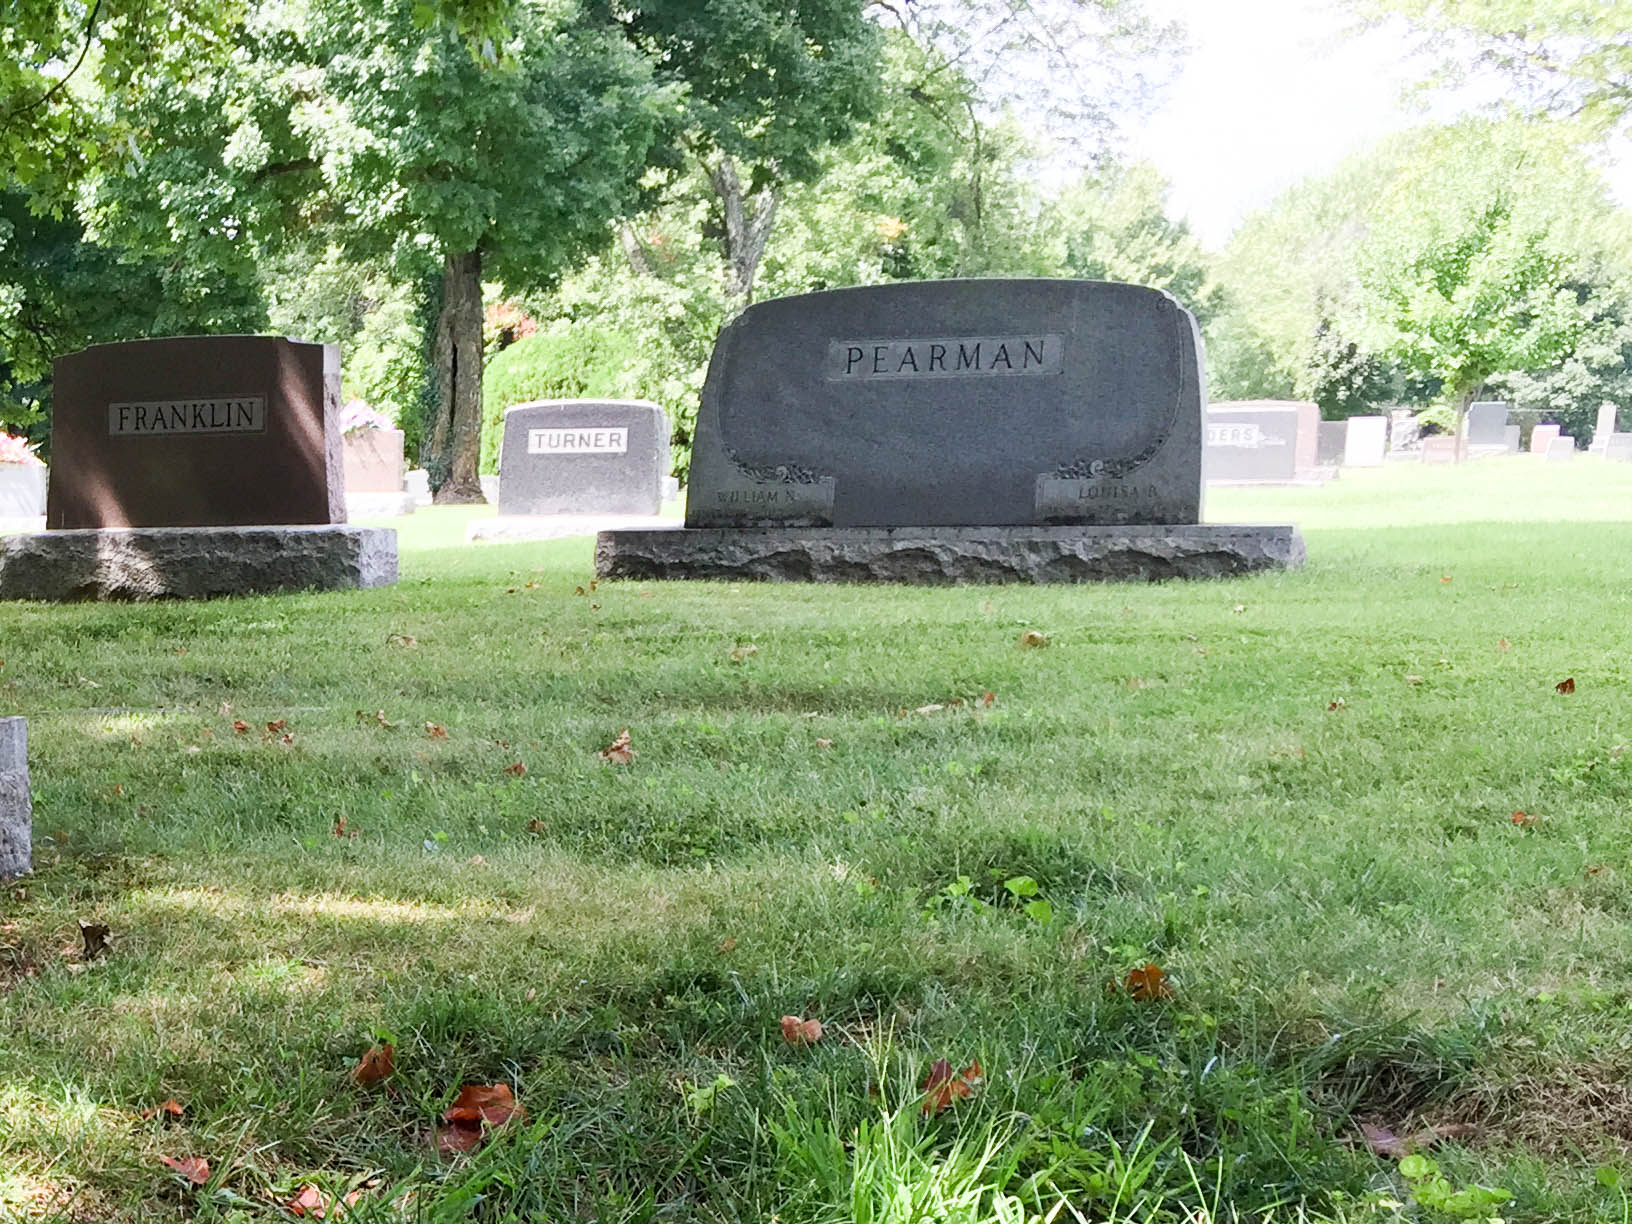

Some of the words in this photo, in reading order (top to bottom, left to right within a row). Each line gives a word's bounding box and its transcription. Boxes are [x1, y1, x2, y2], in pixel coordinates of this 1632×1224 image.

[845, 340, 1046, 375] PEARMAN
[118, 401, 255, 433] FRANKLIN
[534, 431, 622, 449] TURNER
[1079, 485, 1140, 499] LOUISA
